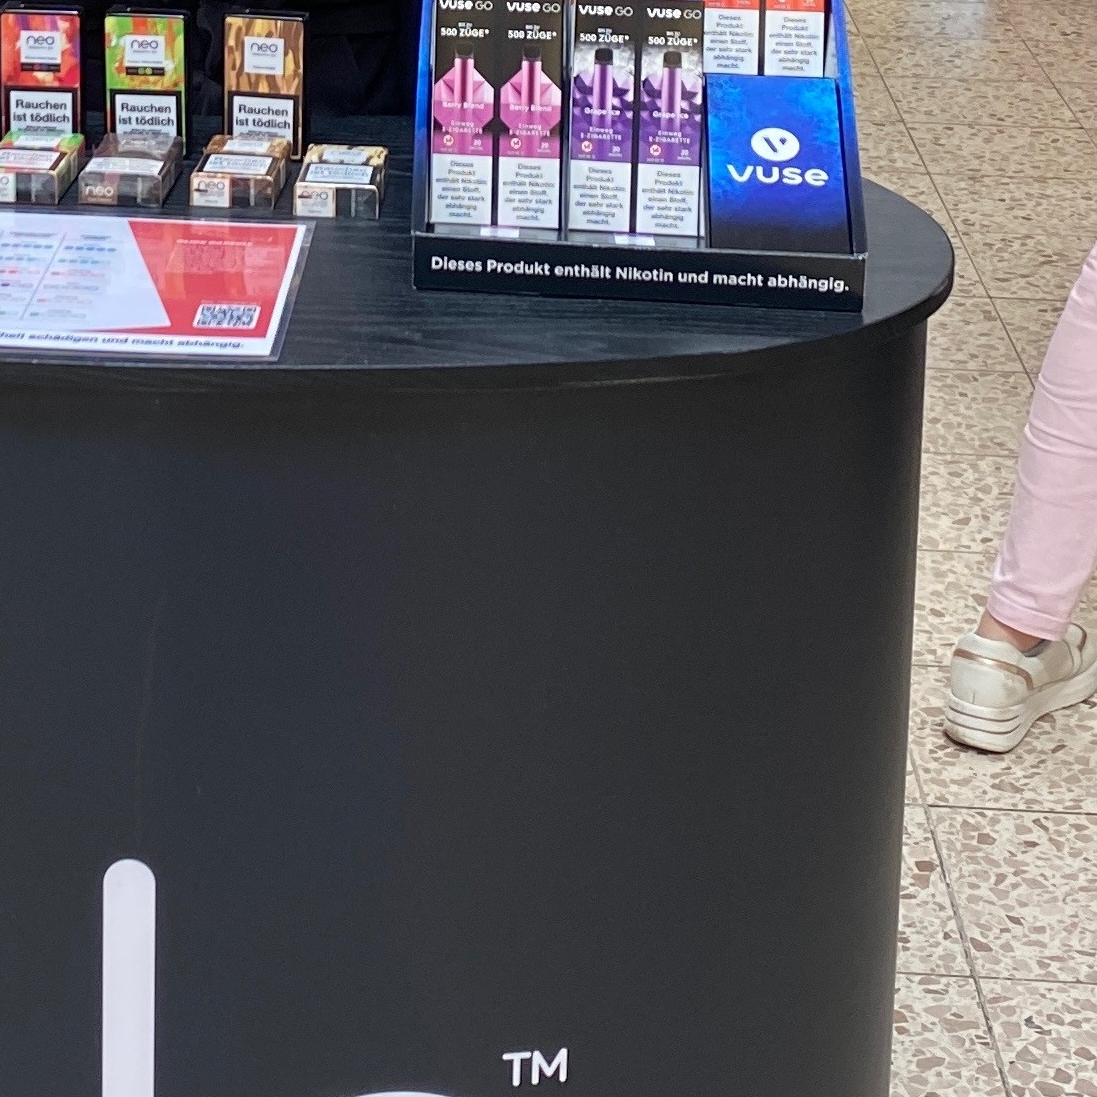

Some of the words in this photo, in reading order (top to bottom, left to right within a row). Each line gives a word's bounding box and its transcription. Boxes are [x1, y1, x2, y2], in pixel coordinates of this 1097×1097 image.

[475, 0, 494, 11] GO
[542, 2, 561, 13] GO
[615, 6, 634, 17] GO
[683, 9, 702, 20] GO
[440, 28, 458, 37] 500
[508, 30, 525, 40] 500
[580, 33, 597, 42] 500
[26, 34, 55, 47] neo
[130, 38, 159, 50] neo
[648, 36, 666, 45] 500
[250, 42, 278, 53] neo
[15, 99, 68, 111] Rauchen
[120, 102, 172, 114] Rauchen
[238, 104, 290, 116] Rauchen
[12, 112, 28, 124] ist
[30, 112, 70, 124] tödlich
[118, 116, 134, 126] ist
[135, 114, 175, 128] tödlich
[235, 118, 250, 128] ist
[252, 116, 291, 129] tödlich
[430, 256, 482, 274] Dieses
[486, 258, 550, 277] Produkt
[554, 263, 612, 280] enthält
[615, 265, 674, 283] Nikotin
[678, 268, 709, 285] und
[712, 270, 764, 288] macht
[768, 273, 850, 294] abhängig.
